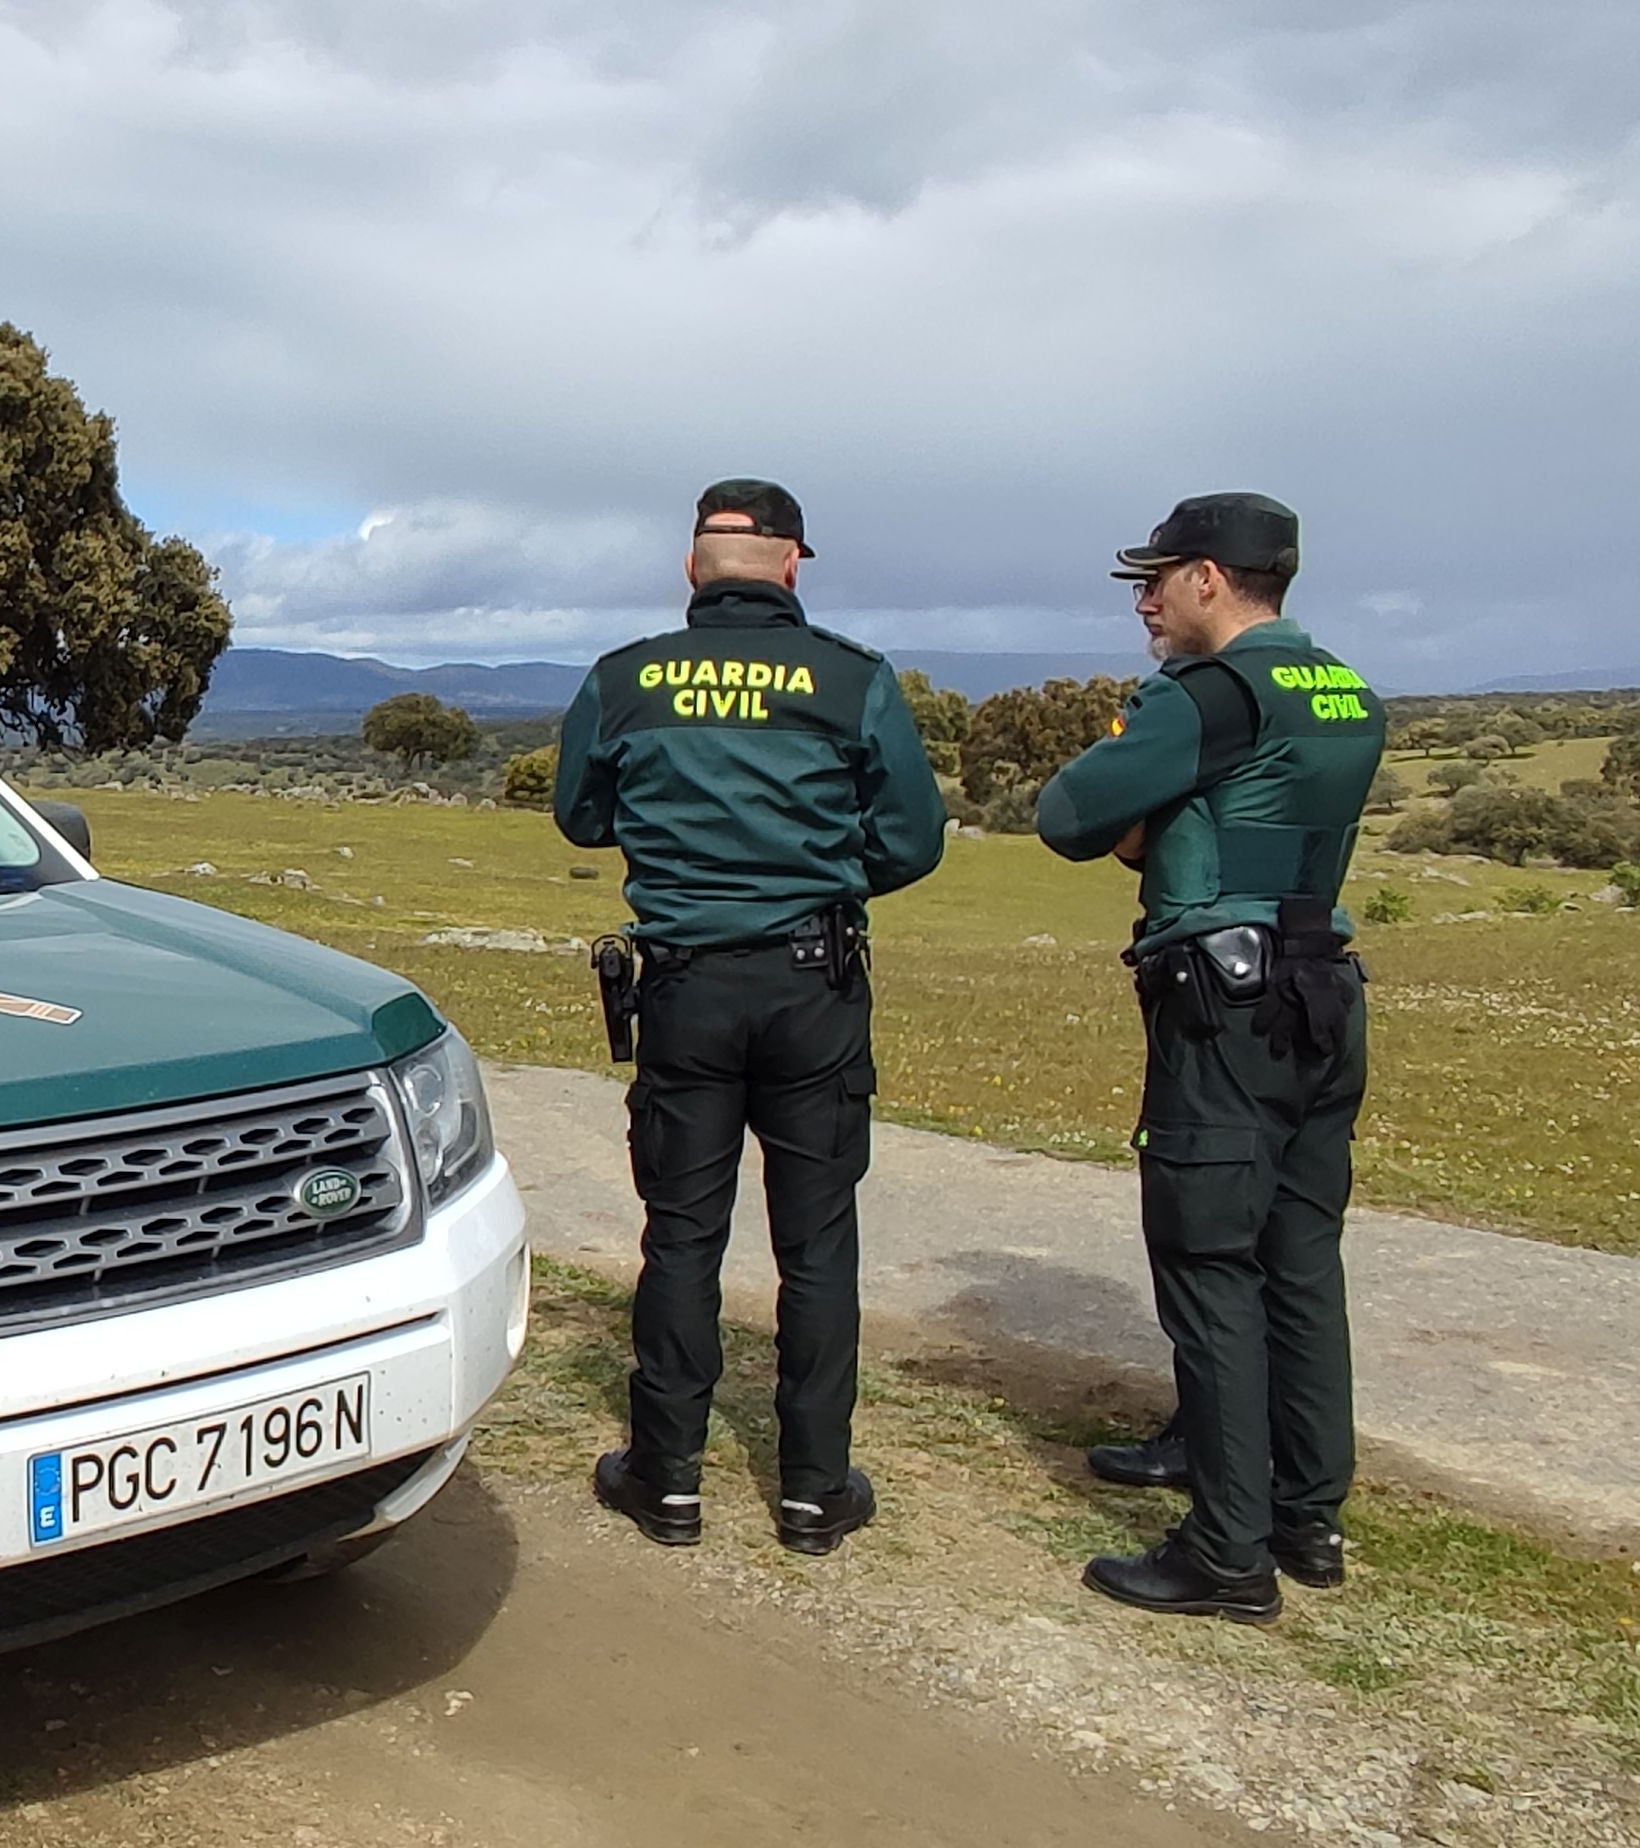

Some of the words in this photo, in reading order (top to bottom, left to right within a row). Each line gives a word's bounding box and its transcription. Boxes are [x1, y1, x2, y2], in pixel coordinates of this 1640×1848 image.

[639, 660, 814, 694] GUARDIA
[673, 689, 769, 720] CIVIL
[1311, 693, 1369, 720] CIVIL
[70, 1437, 177, 1523] PGC
[196, 1399, 324, 1492] 7196
[334, 1384, 364, 1451] N
[39, 1504, 56, 1529] E
